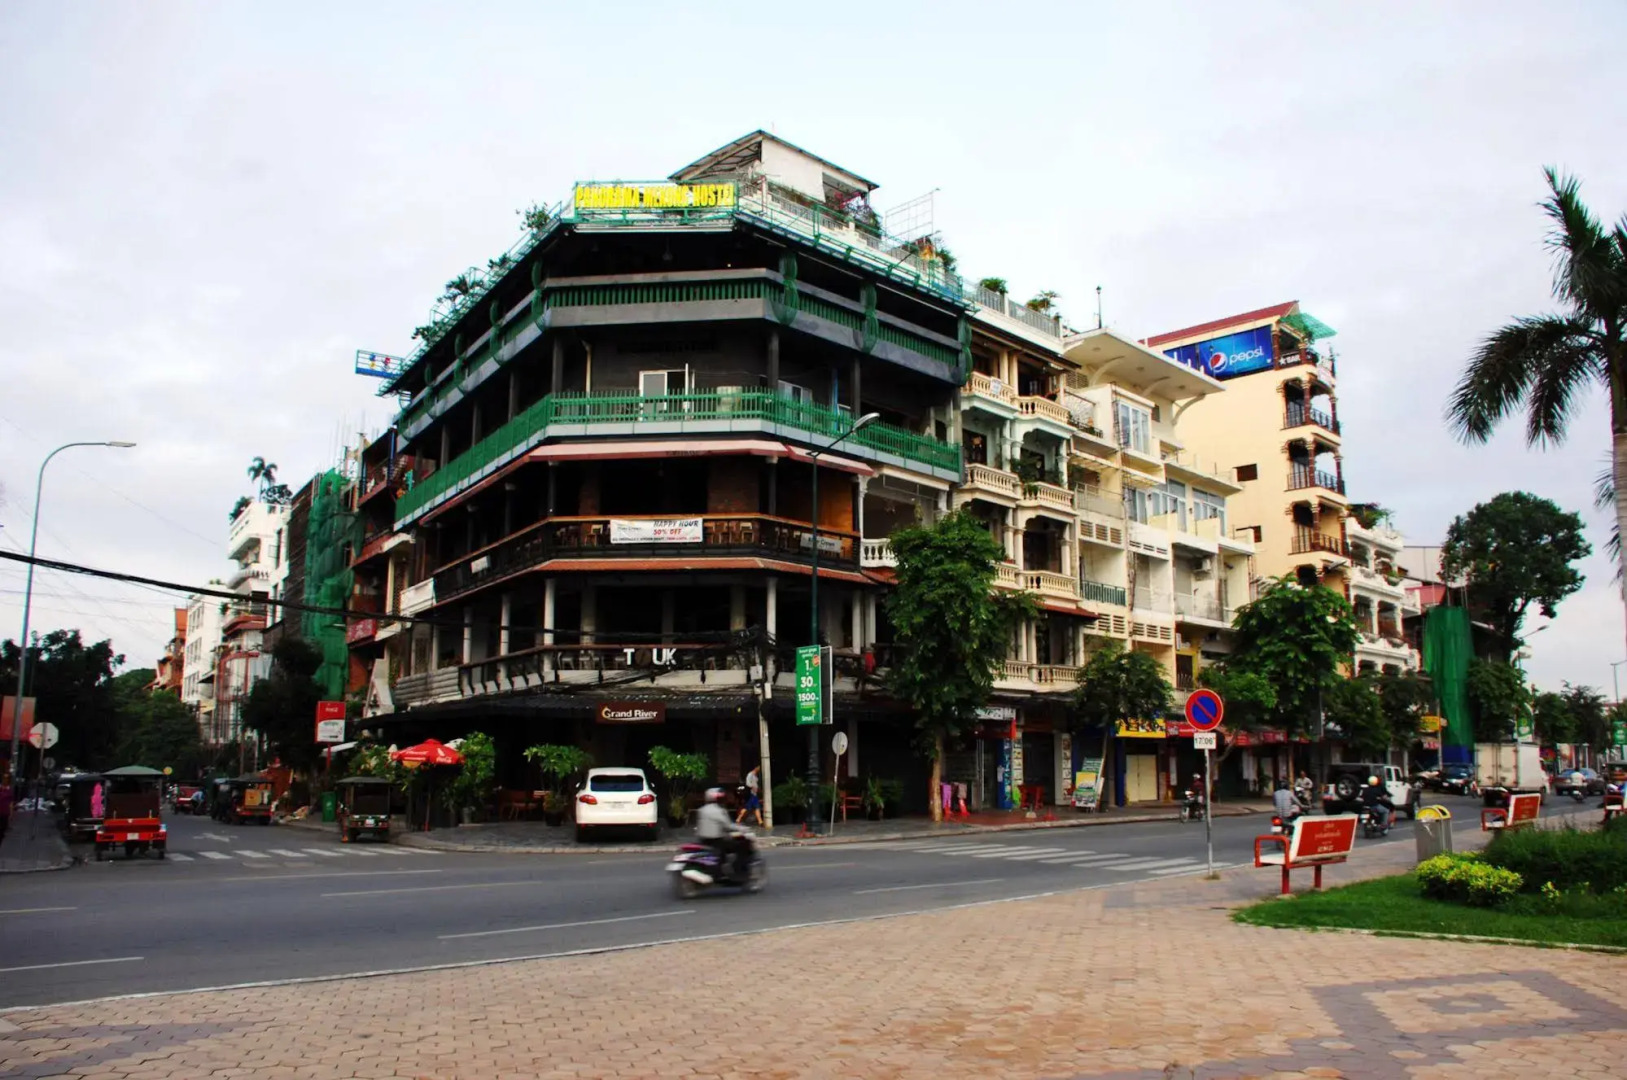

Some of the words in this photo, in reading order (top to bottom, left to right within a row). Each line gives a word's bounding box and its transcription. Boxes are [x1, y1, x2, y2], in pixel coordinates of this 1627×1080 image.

[692, 183, 734, 206] HOSTEL
[1229, 345, 1264, 365] pepsi
[653, 520, 677, 528] HAPPY
[678, 519, 699, 527] HOUR
[653, 528, 667, 536] 50%
[669, 527, 682, 535] OFF
[800, 676, 814, 688] 30
[798, 692, 816, 701] 1500
[601, 706, 633, 719] Grand
[634, 709, 658, 718] River
